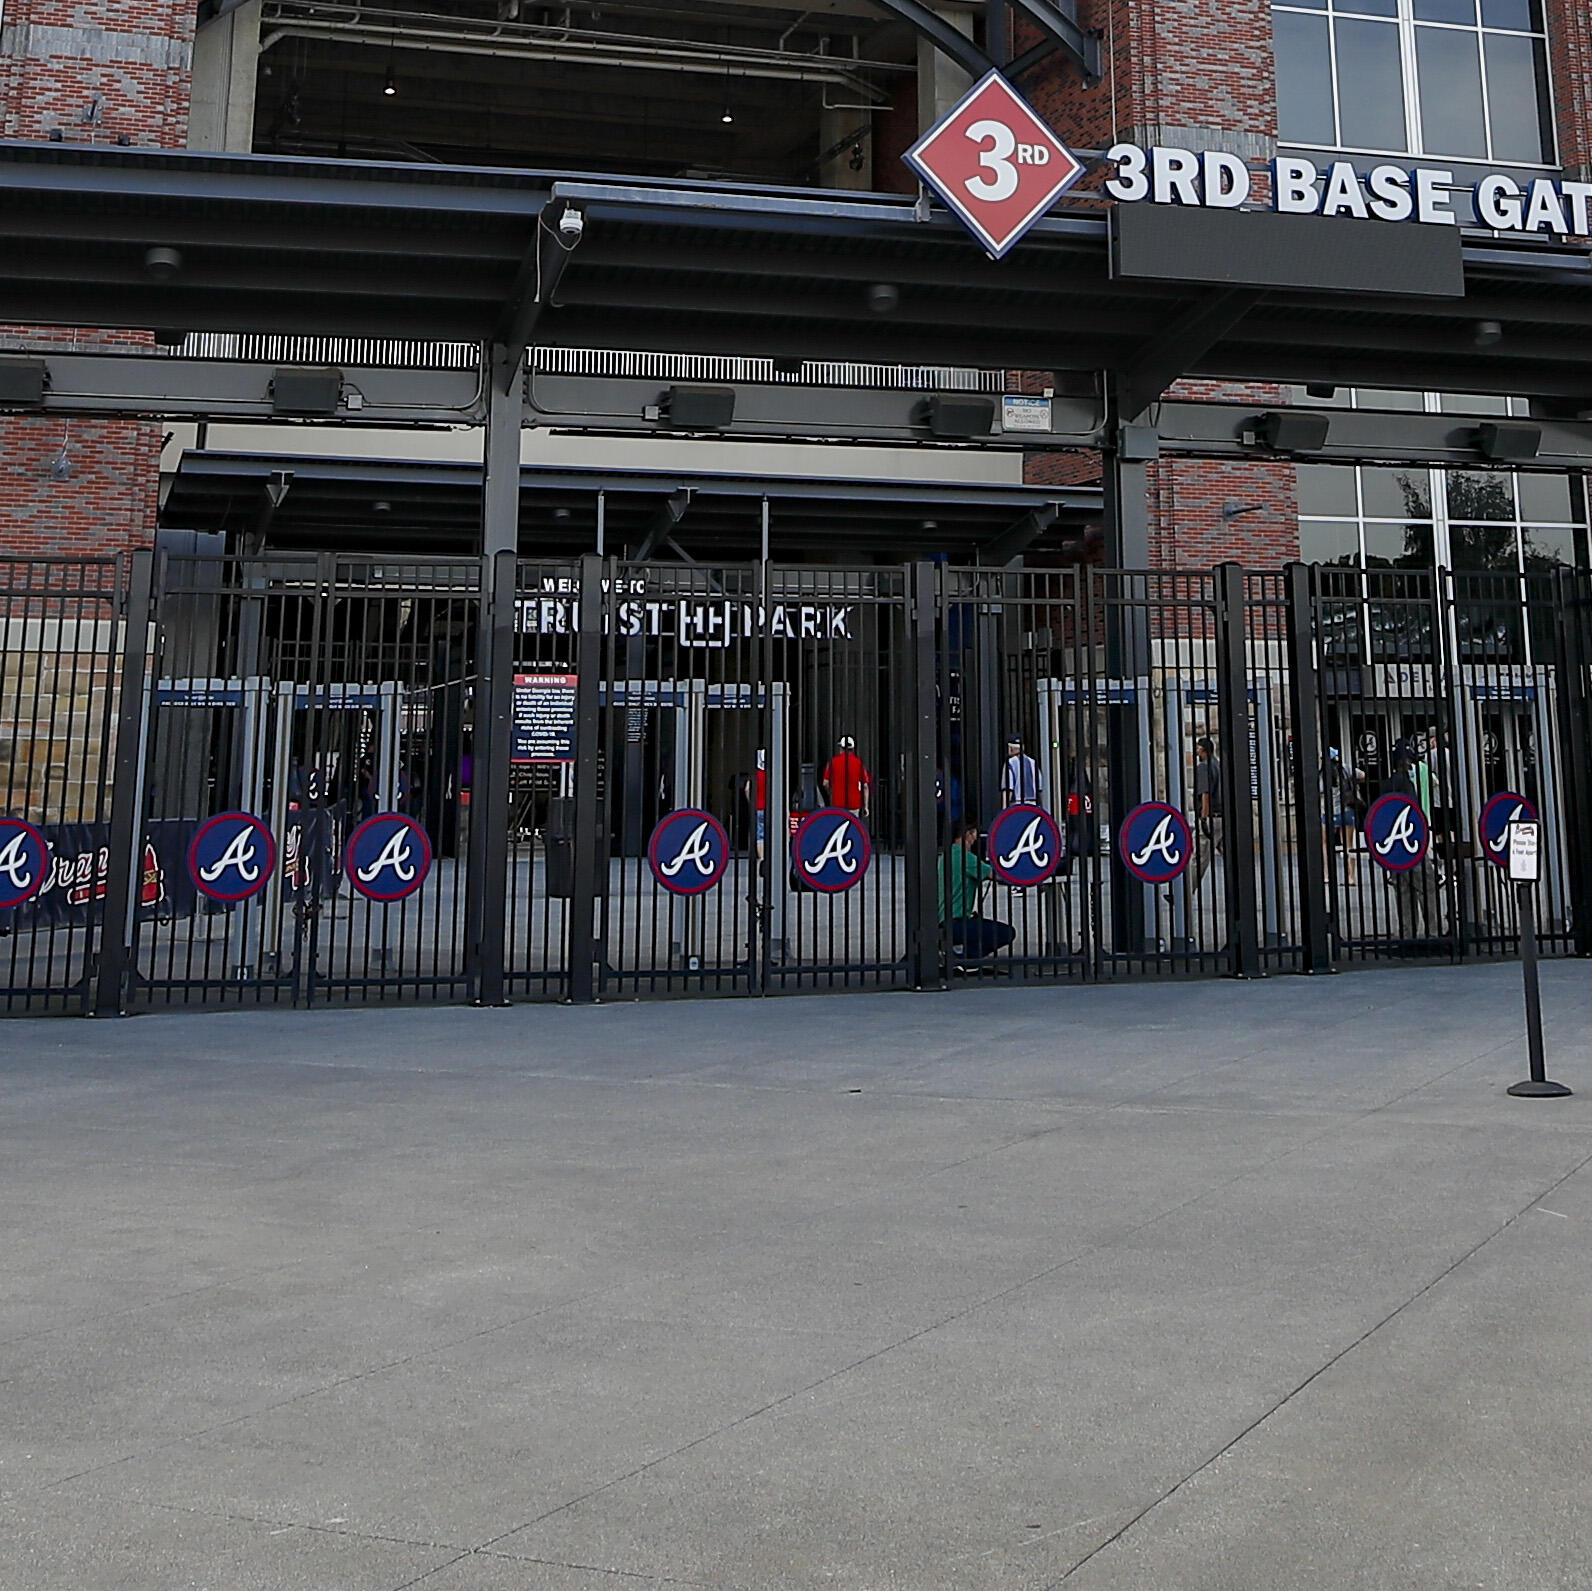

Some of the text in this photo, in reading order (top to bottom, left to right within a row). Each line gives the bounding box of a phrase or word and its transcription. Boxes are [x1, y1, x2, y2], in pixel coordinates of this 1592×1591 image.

[1105, 143, 1251, 209] 3RD
[1271, 157, 1458, 224] BASE
[514, 600, 854, 639] TRUST PARK
[524, 676, 567, 684] WARNING
[200, 825, 259, 881] A
[357, 825, 415, 882] A
[660, 822, 714, 876] A
[804, 820, 857, 874] A
[999, 816, 1049, 869] A
[1131, 814, 1180, 865] A
[1375, 805, 1419, 854] A
